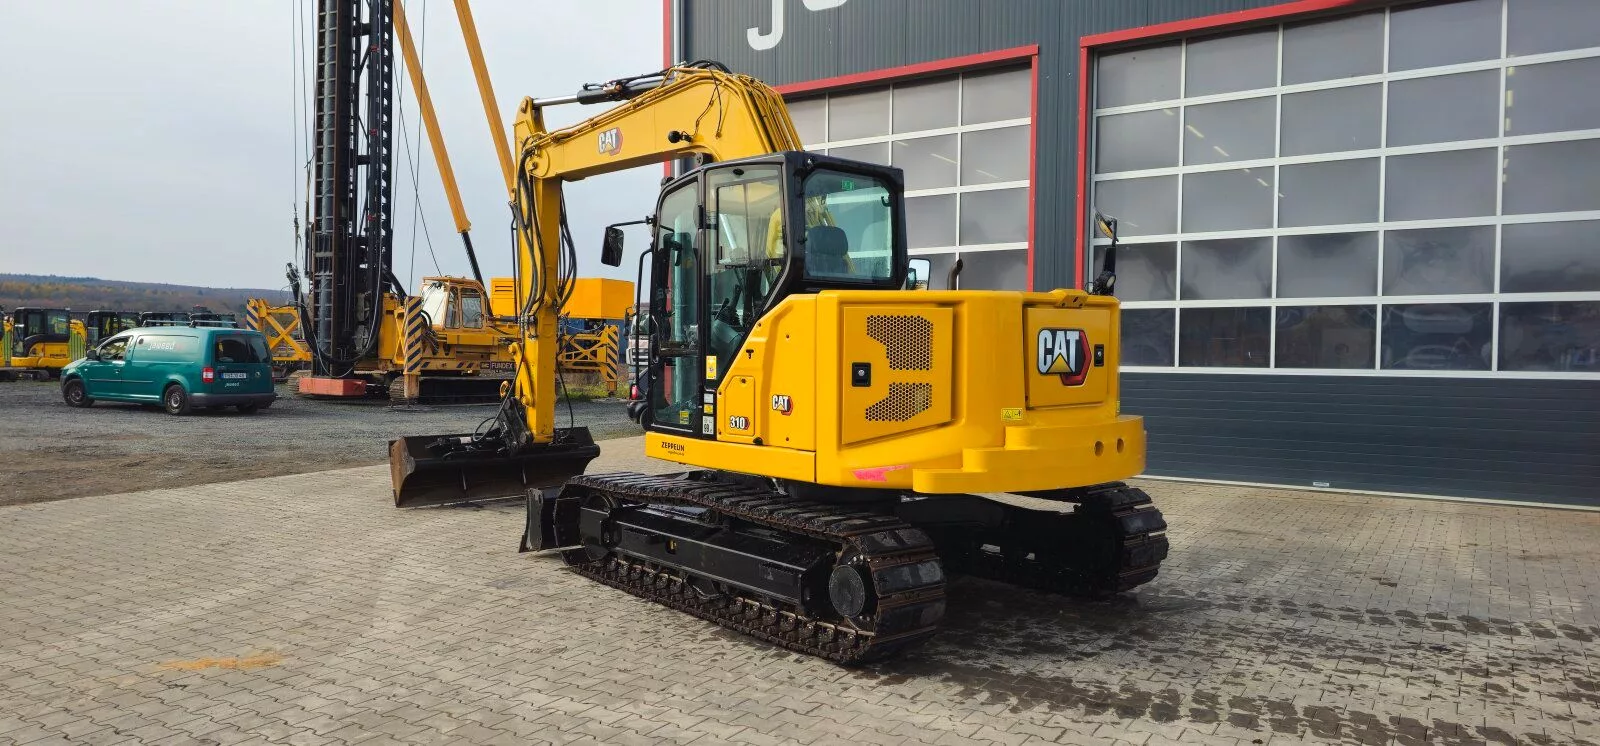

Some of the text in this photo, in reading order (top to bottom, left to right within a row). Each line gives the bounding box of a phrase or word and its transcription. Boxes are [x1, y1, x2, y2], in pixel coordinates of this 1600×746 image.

[598, 128, 617, 153] CAT
[1038, 329, 1080, 374] CAT
[772, 395, 789, 412] CAT
[729, 416, 745, 429] 310
[661, 441, 685, 452] ZEPPELIN
